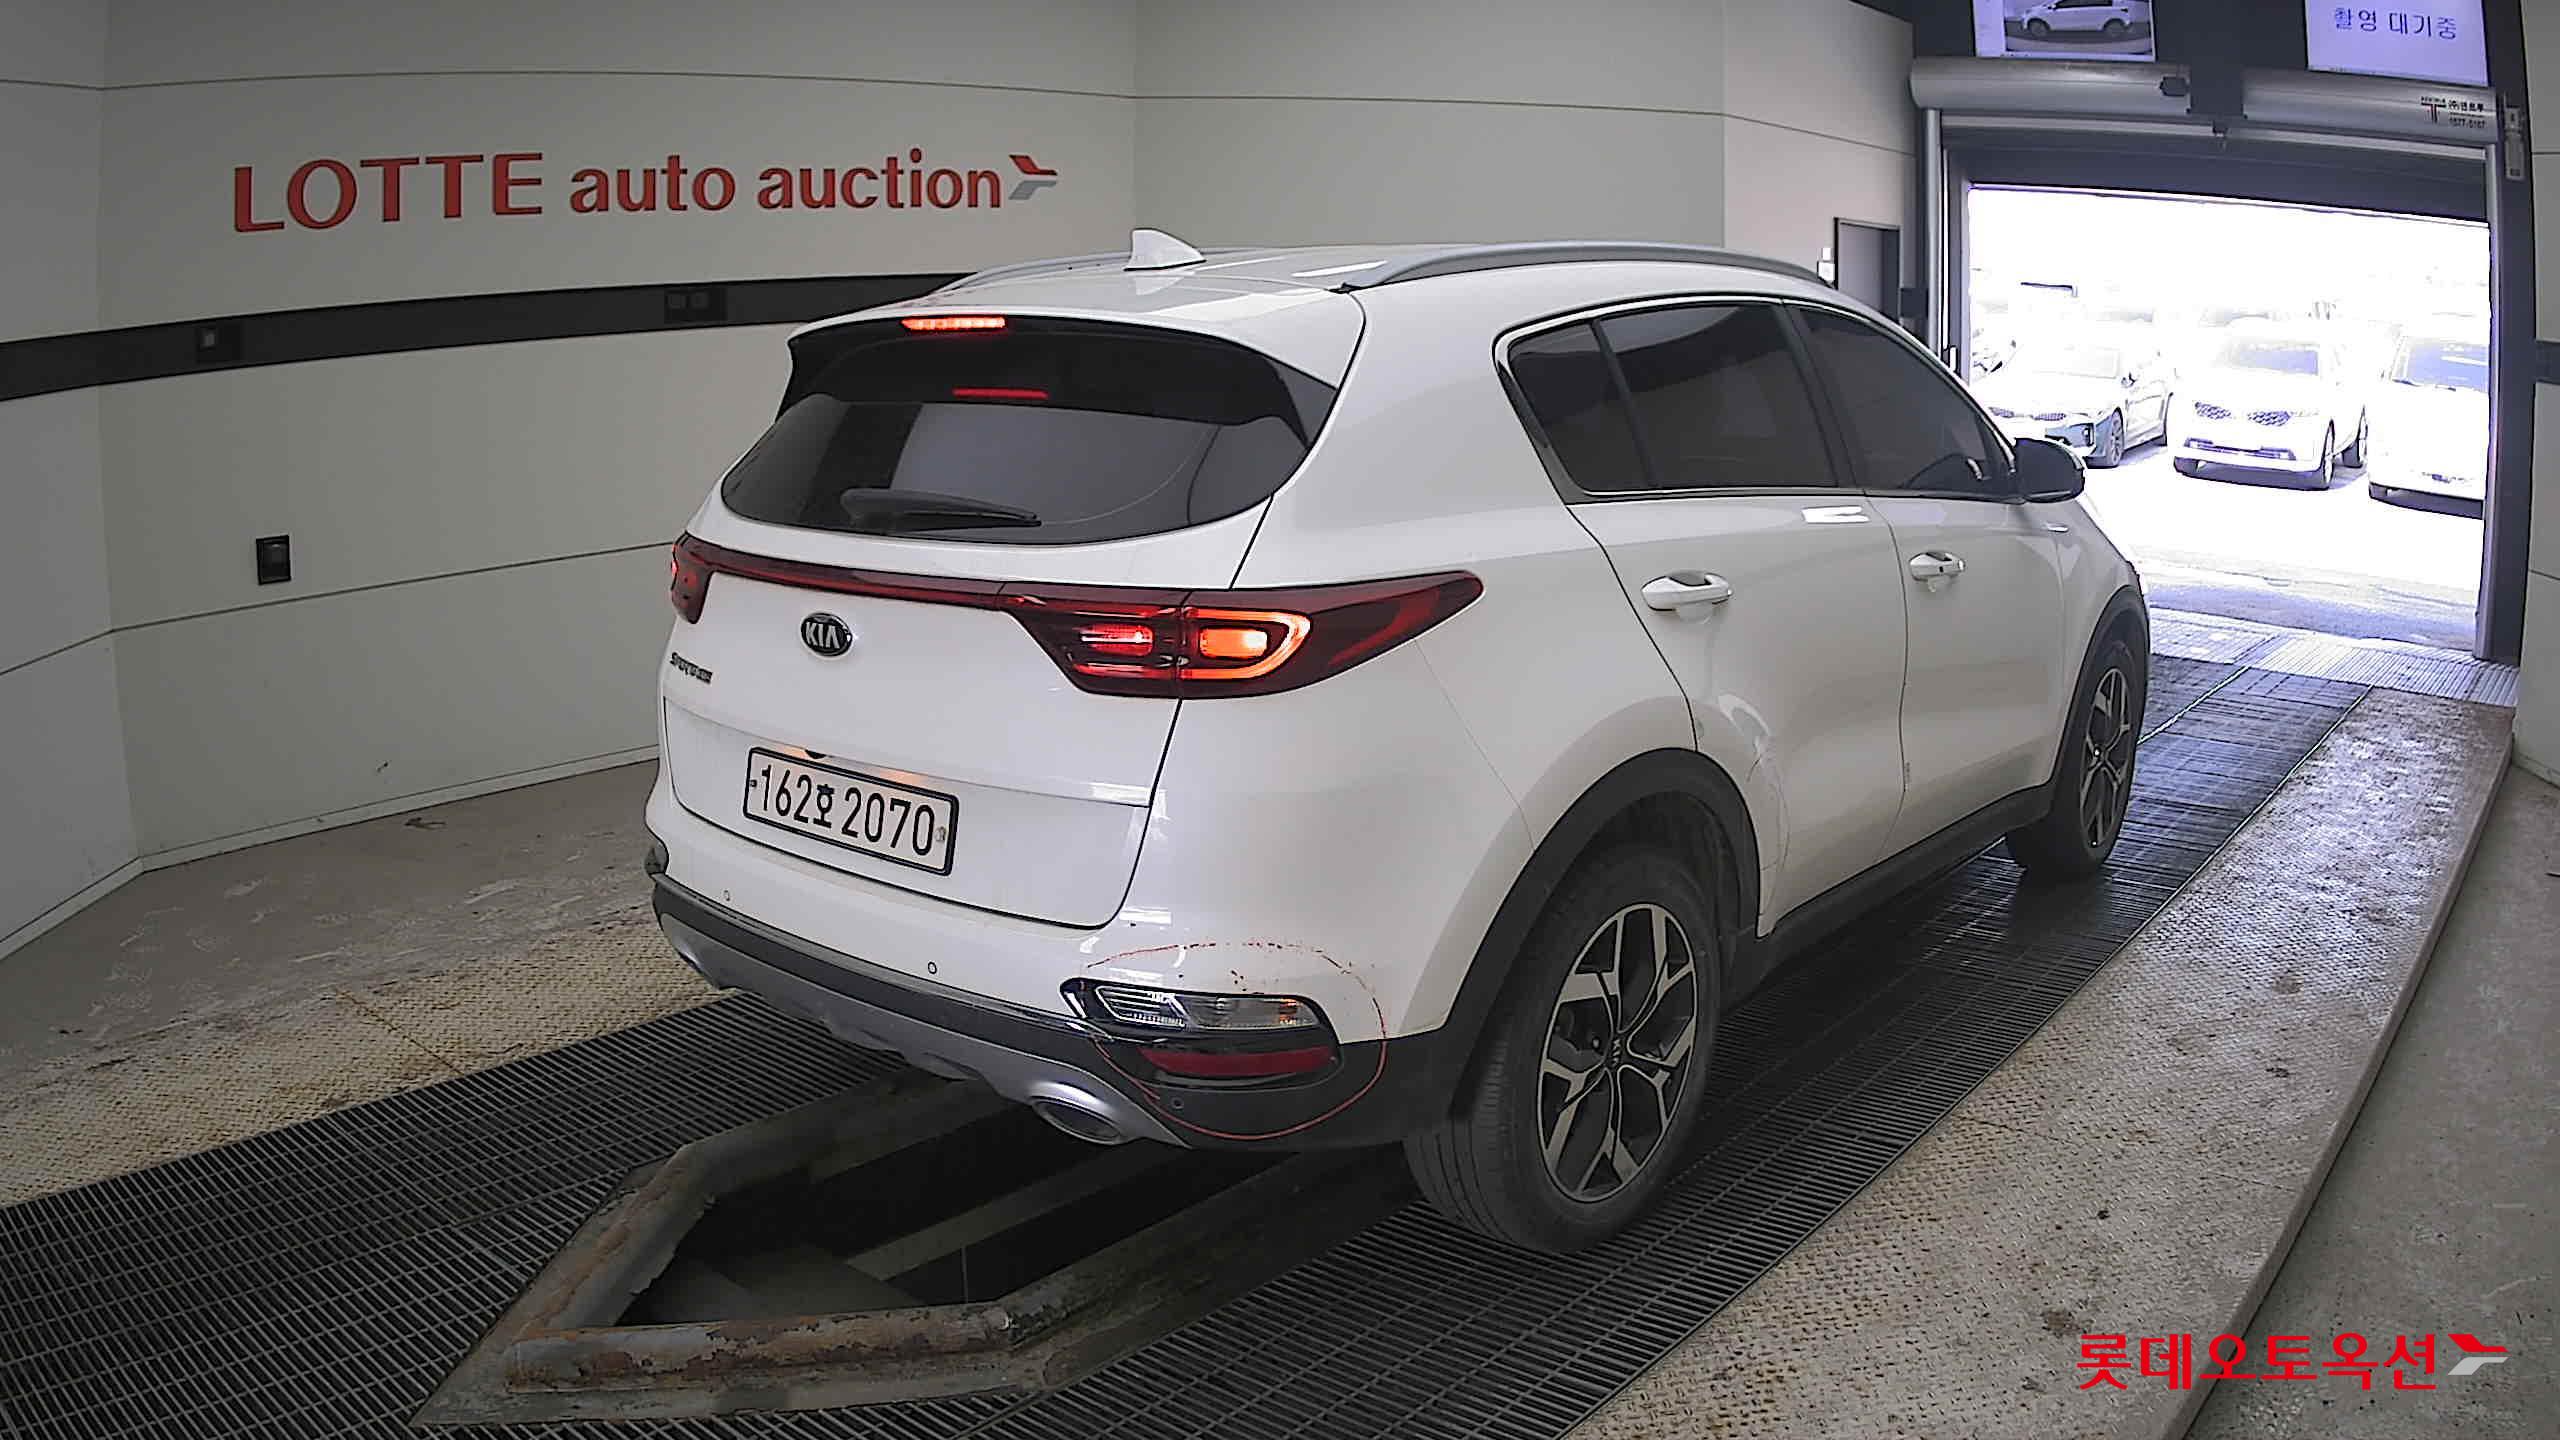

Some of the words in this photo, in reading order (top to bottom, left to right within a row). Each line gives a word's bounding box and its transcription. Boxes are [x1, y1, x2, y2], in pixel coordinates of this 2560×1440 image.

[2388, 12, 2458, 40] 대기중
[234, 153, 544, 233] LOTTE
[570, 155, 738, 213] auto
[757, 149, 1002, 211] auction
[804, 621, 841, 650] KIA
